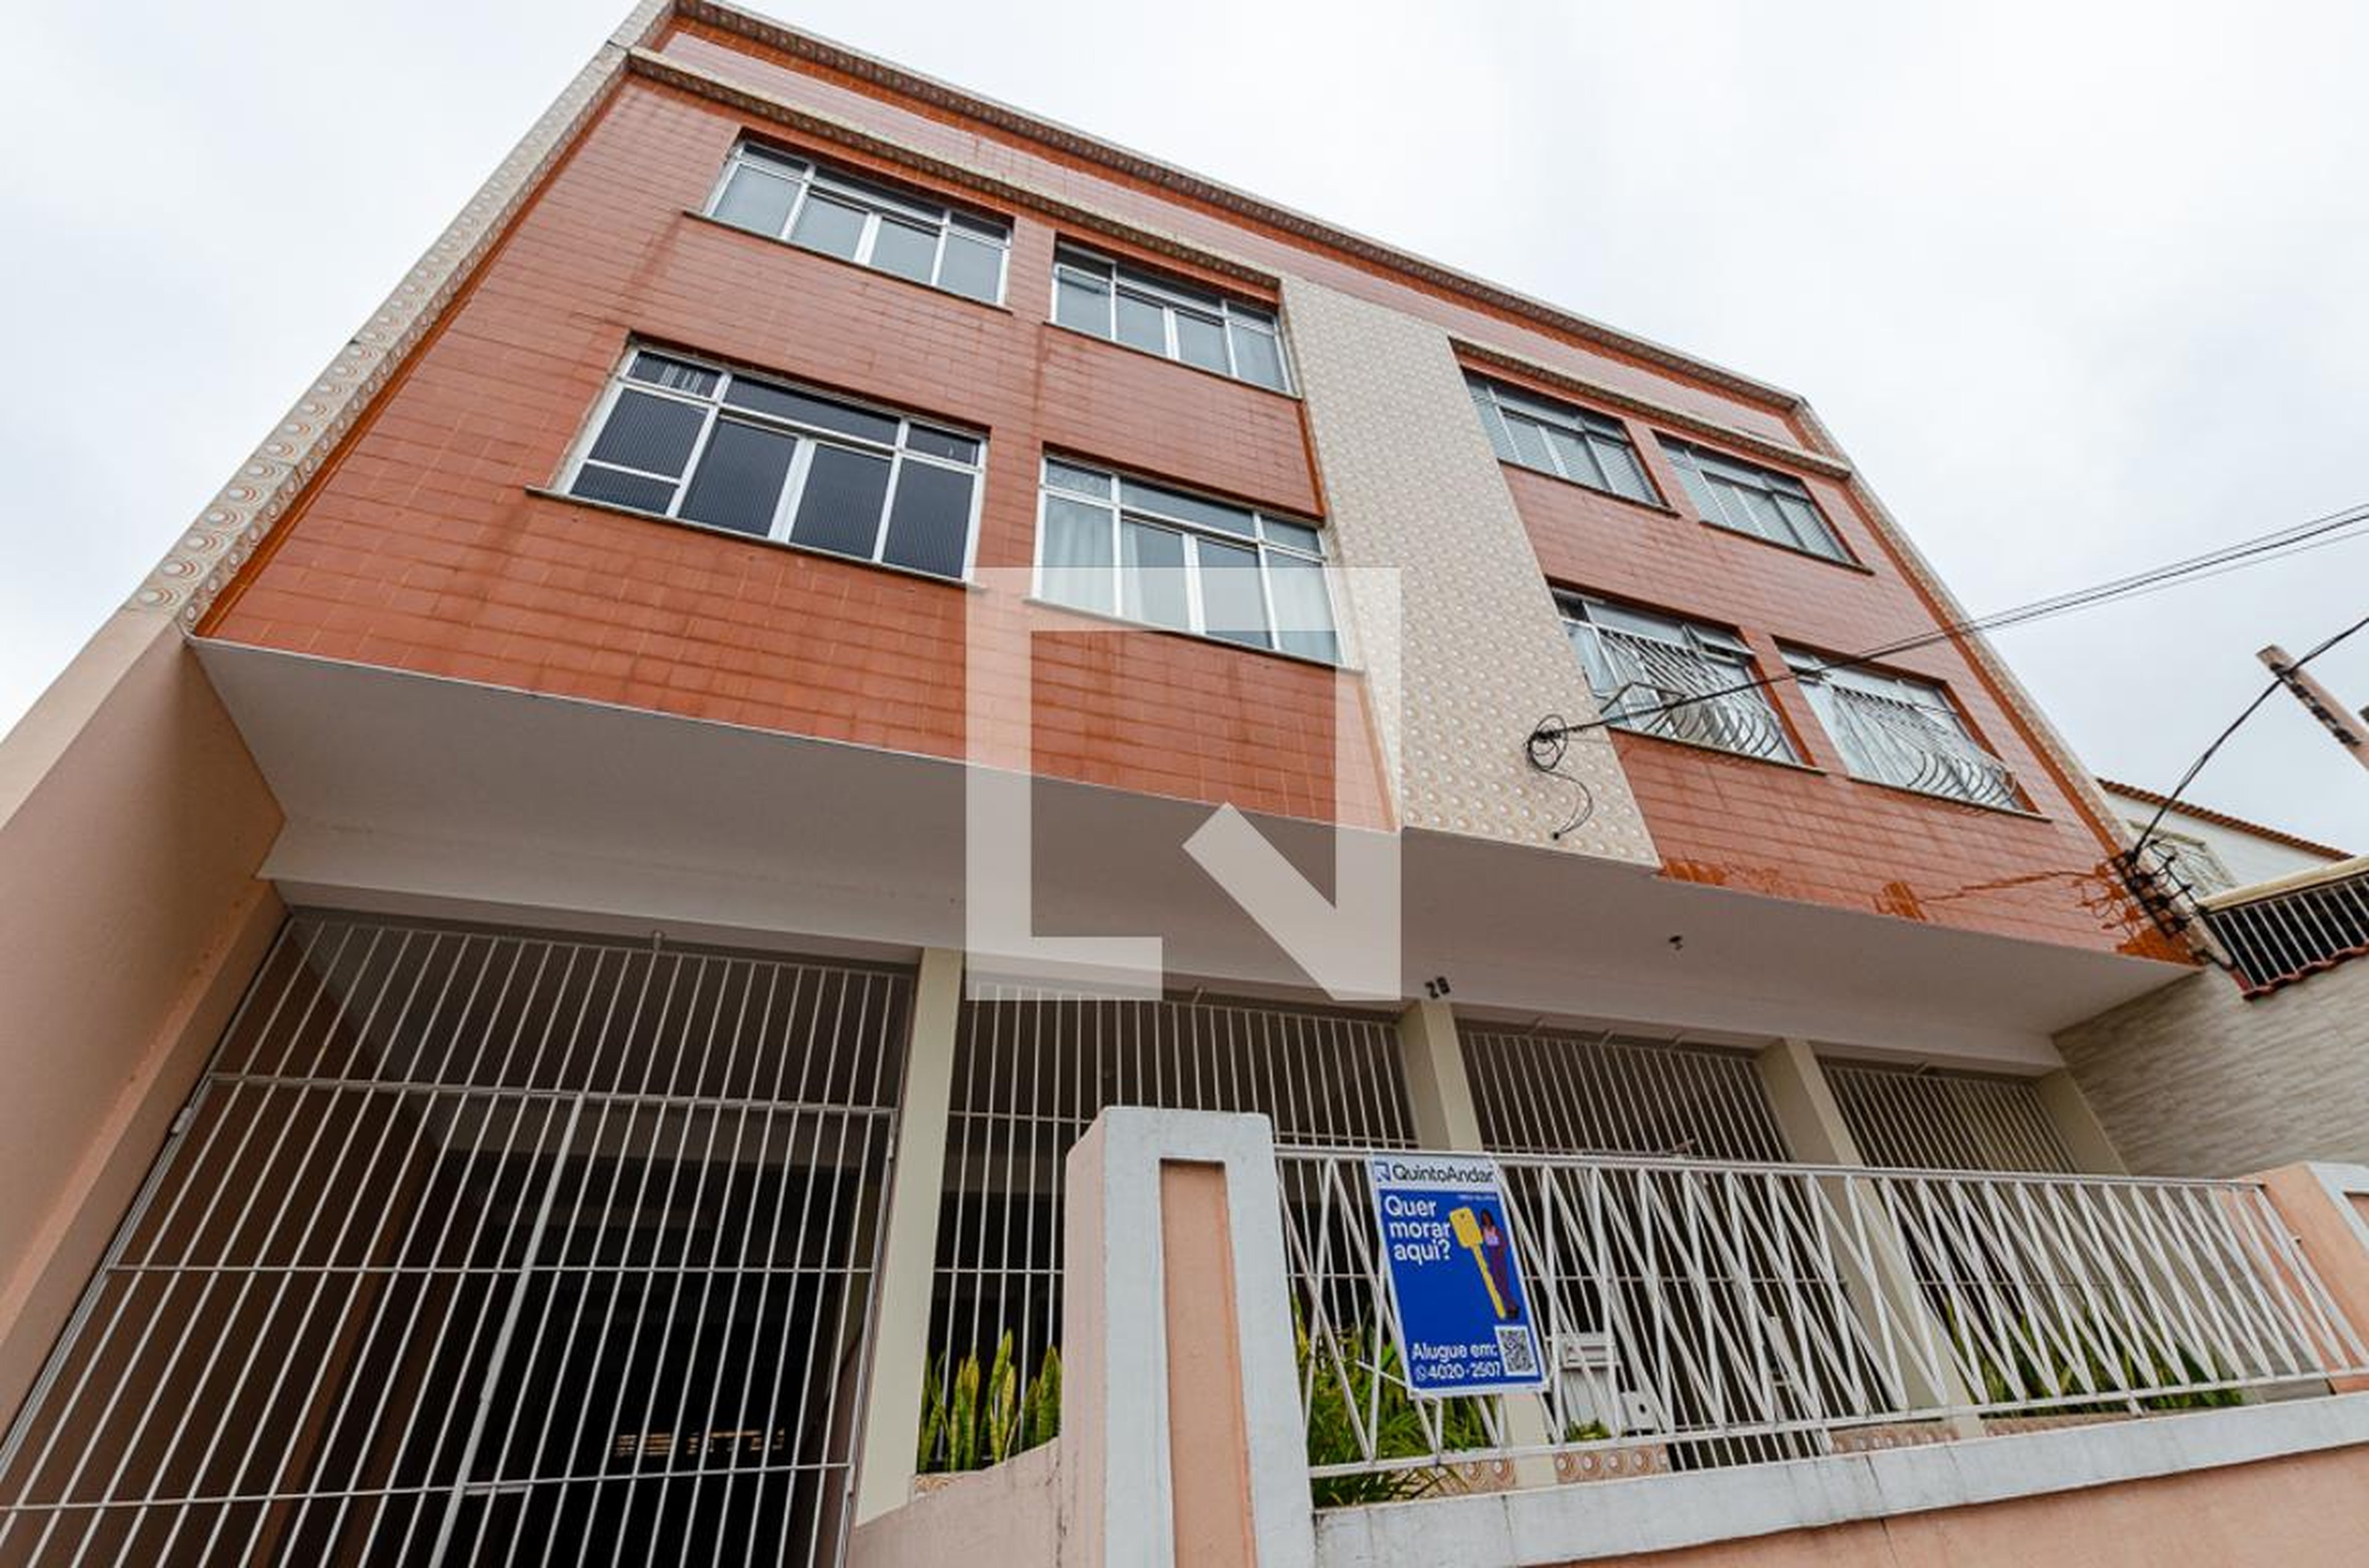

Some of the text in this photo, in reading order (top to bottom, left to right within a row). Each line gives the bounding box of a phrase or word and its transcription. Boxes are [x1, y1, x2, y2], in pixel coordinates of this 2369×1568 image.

[1392, 1163, 1494, 1183] QuintoAndar
[1384, 1195, 1437, 1218] Quer
[1388, 1221, 1451, 1239] morar
[1394, 1238, 1451, 1266] aqui?
[1470, 1343, 1498, 1358] em:
